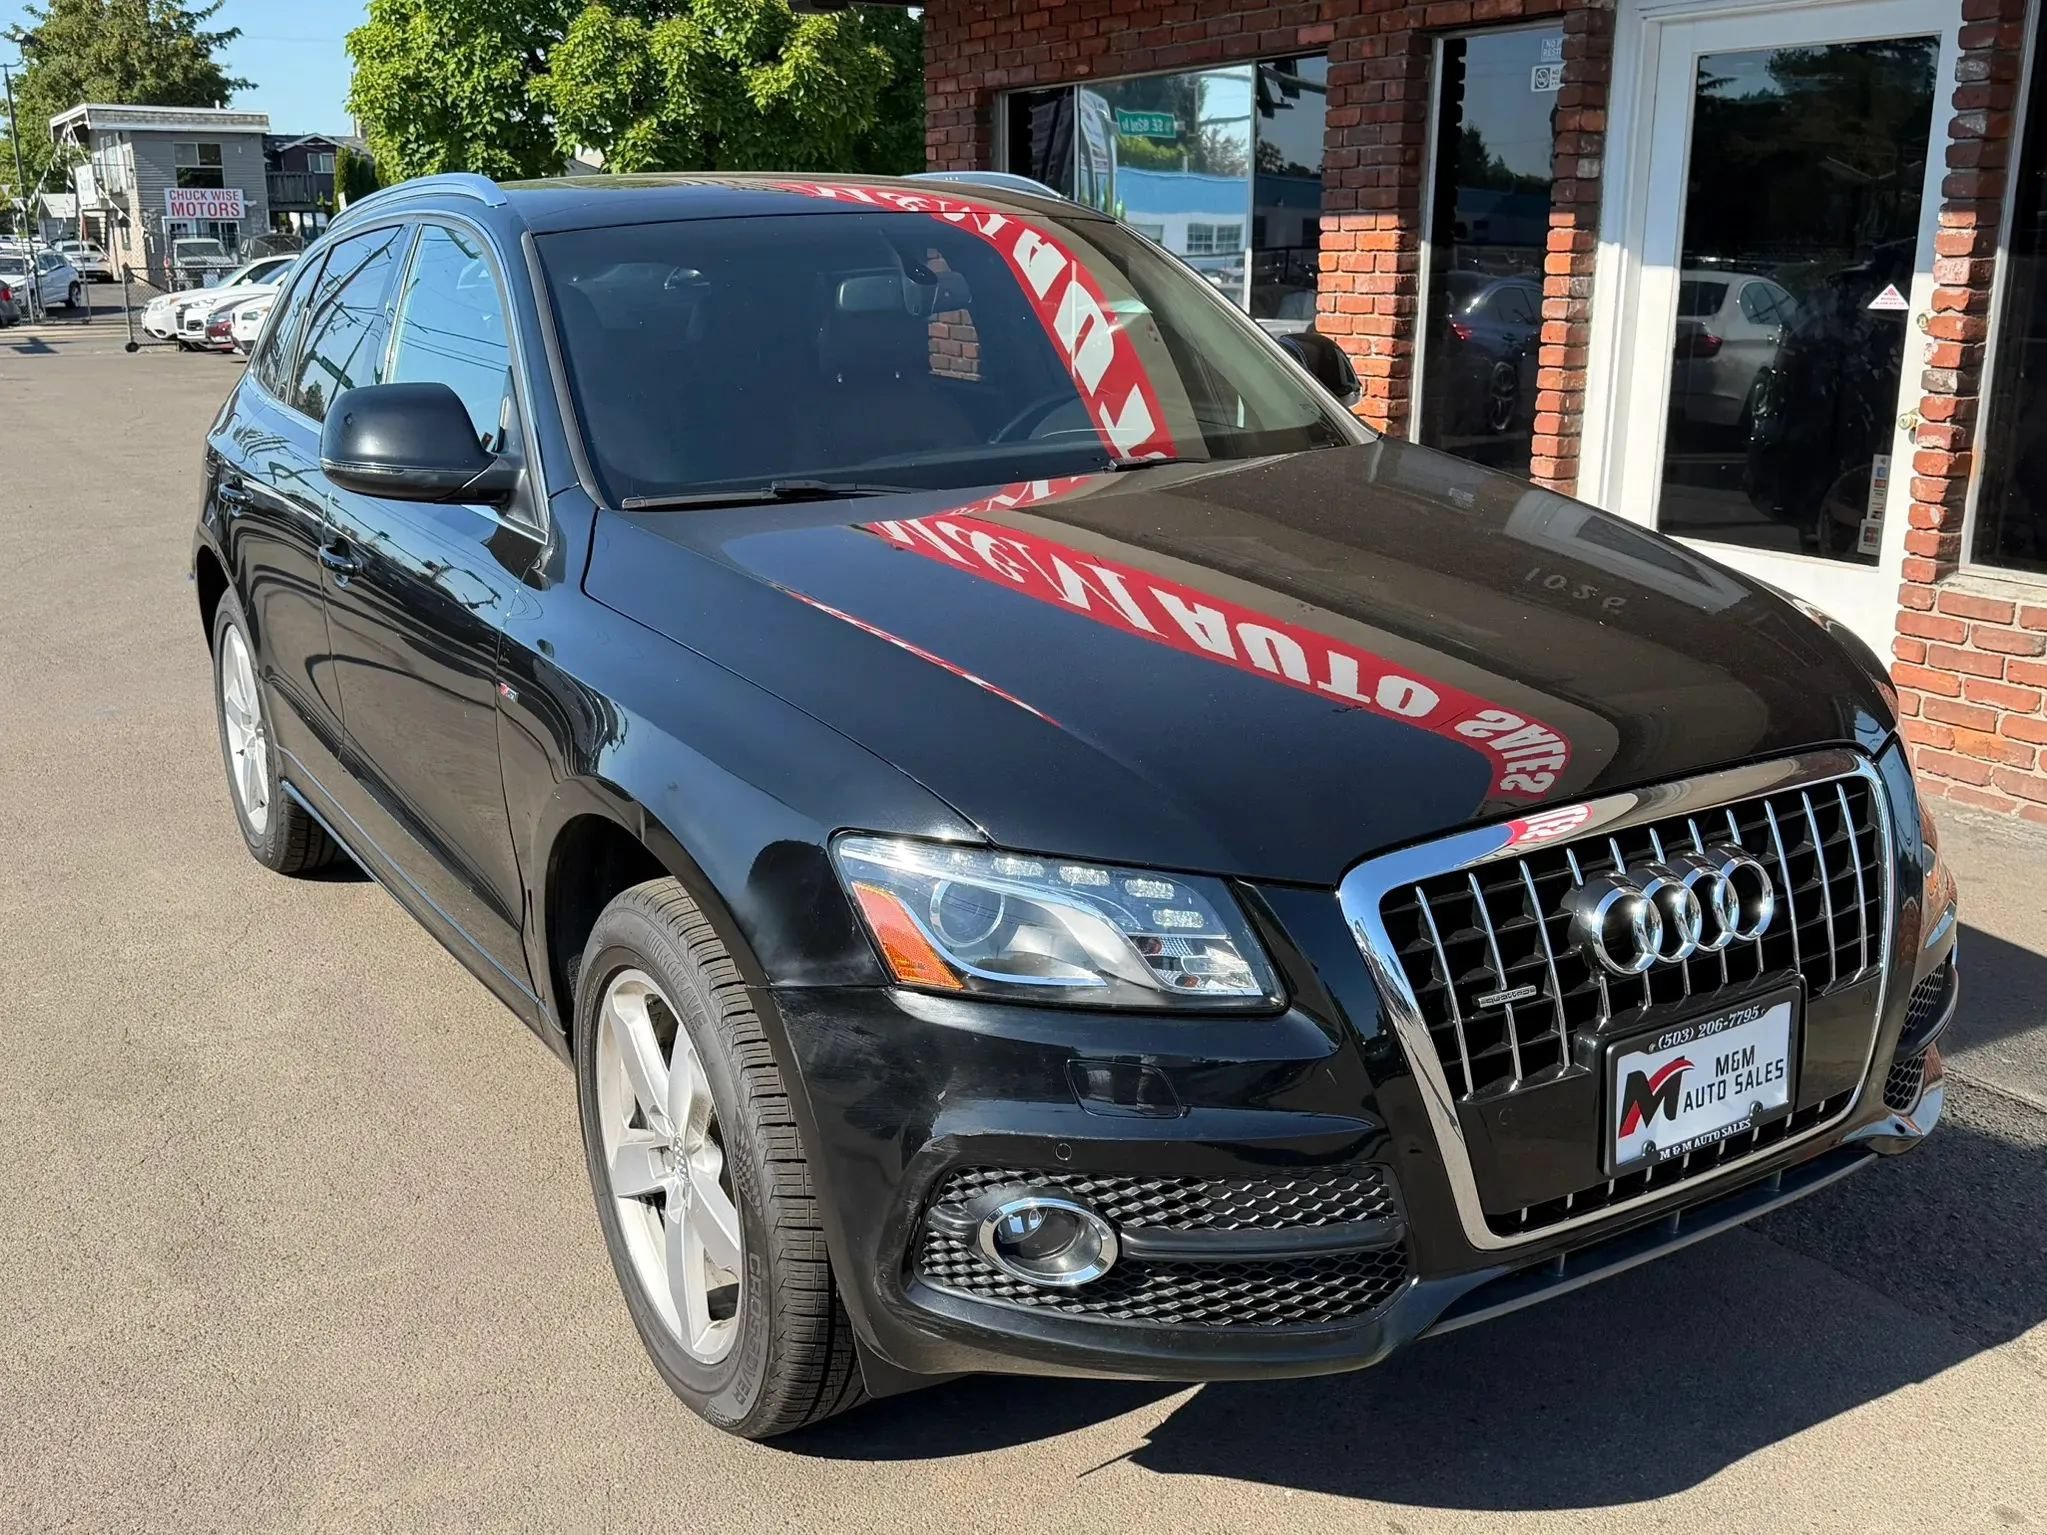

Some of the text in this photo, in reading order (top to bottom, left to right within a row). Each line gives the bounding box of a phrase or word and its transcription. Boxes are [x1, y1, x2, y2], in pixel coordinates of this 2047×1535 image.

[169, 189, 239, 201] CHUCK WISE
[170, 202, 240, 217] MOTORS
[1657, 1004, 1761, 1050] (503) 206-7795
[1715, 1044, 1756, 1078] M&M
[1683, 1058, 1785, 1113] AUTO SALES
[1659, 1118, 1752, 1161] M & M AUTO SALES
[732, 1252, 763, 1406] CROSSOVER
